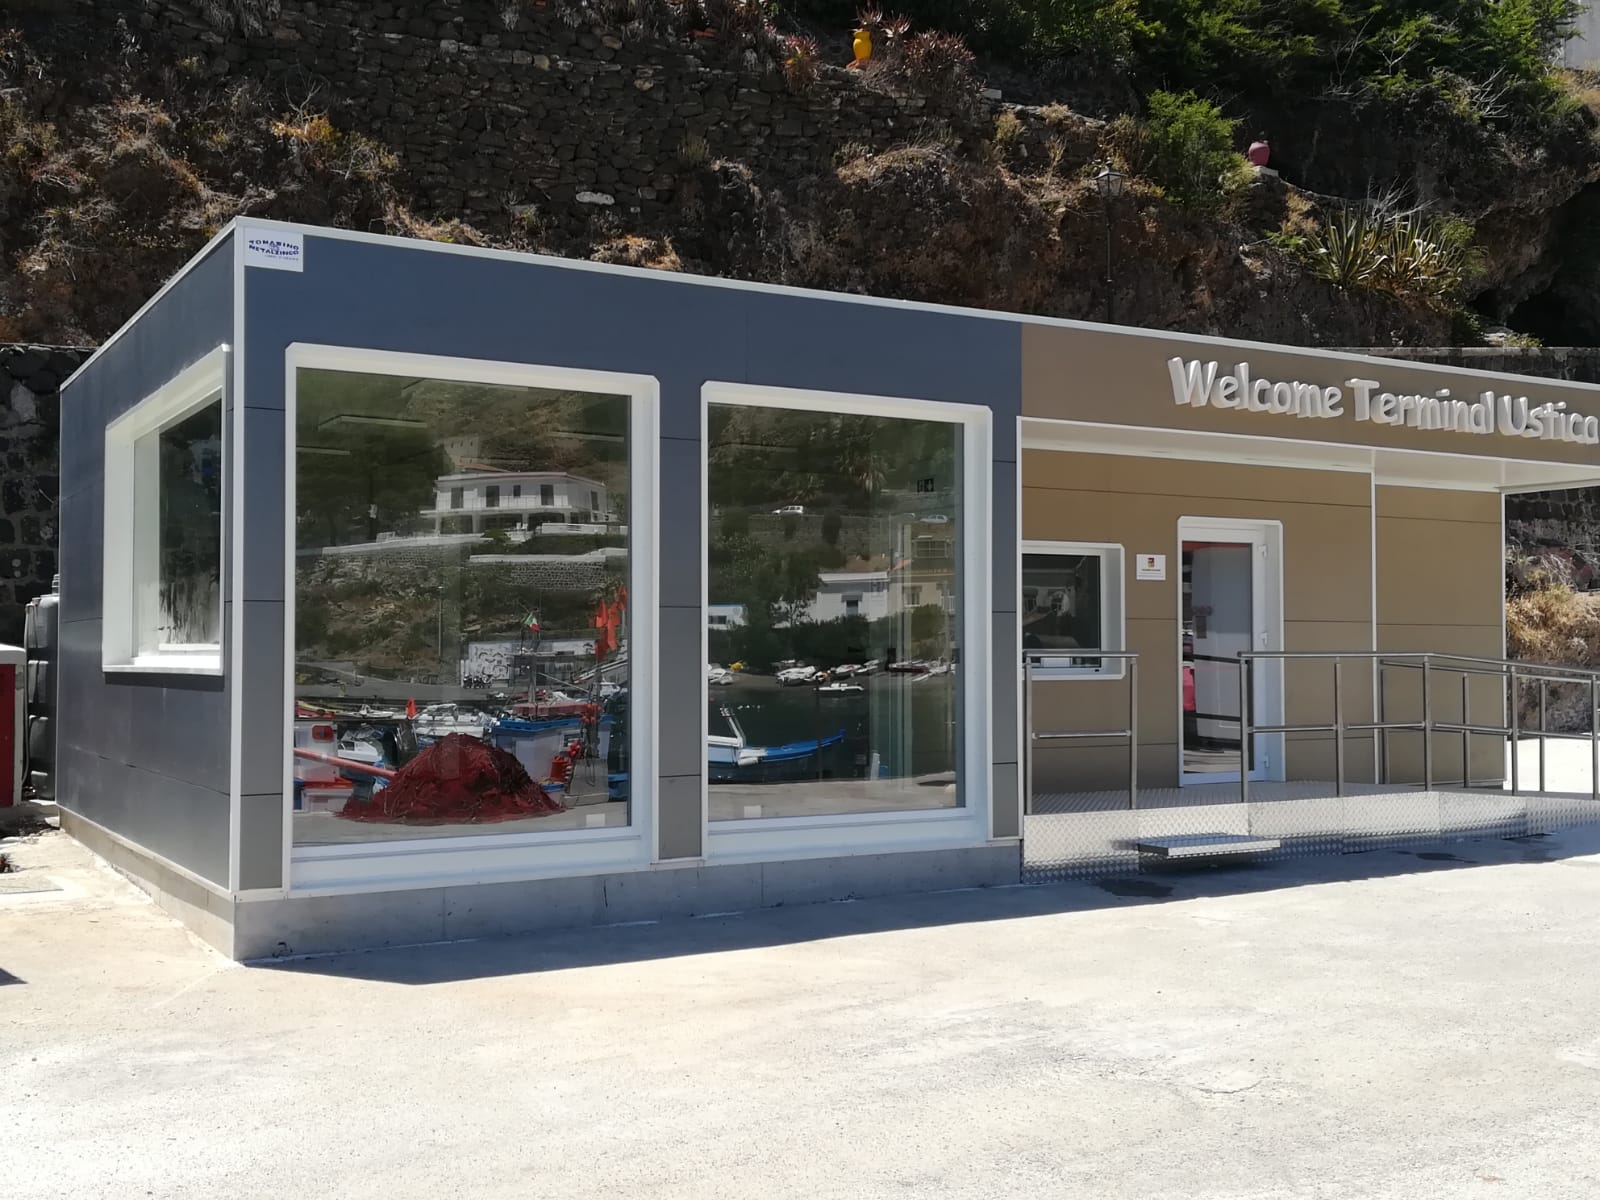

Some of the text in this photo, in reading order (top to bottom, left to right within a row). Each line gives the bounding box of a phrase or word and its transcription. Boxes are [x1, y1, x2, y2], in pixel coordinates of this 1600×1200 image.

[1167, 356, 1599, 445] Welcome Terminal Ustica
